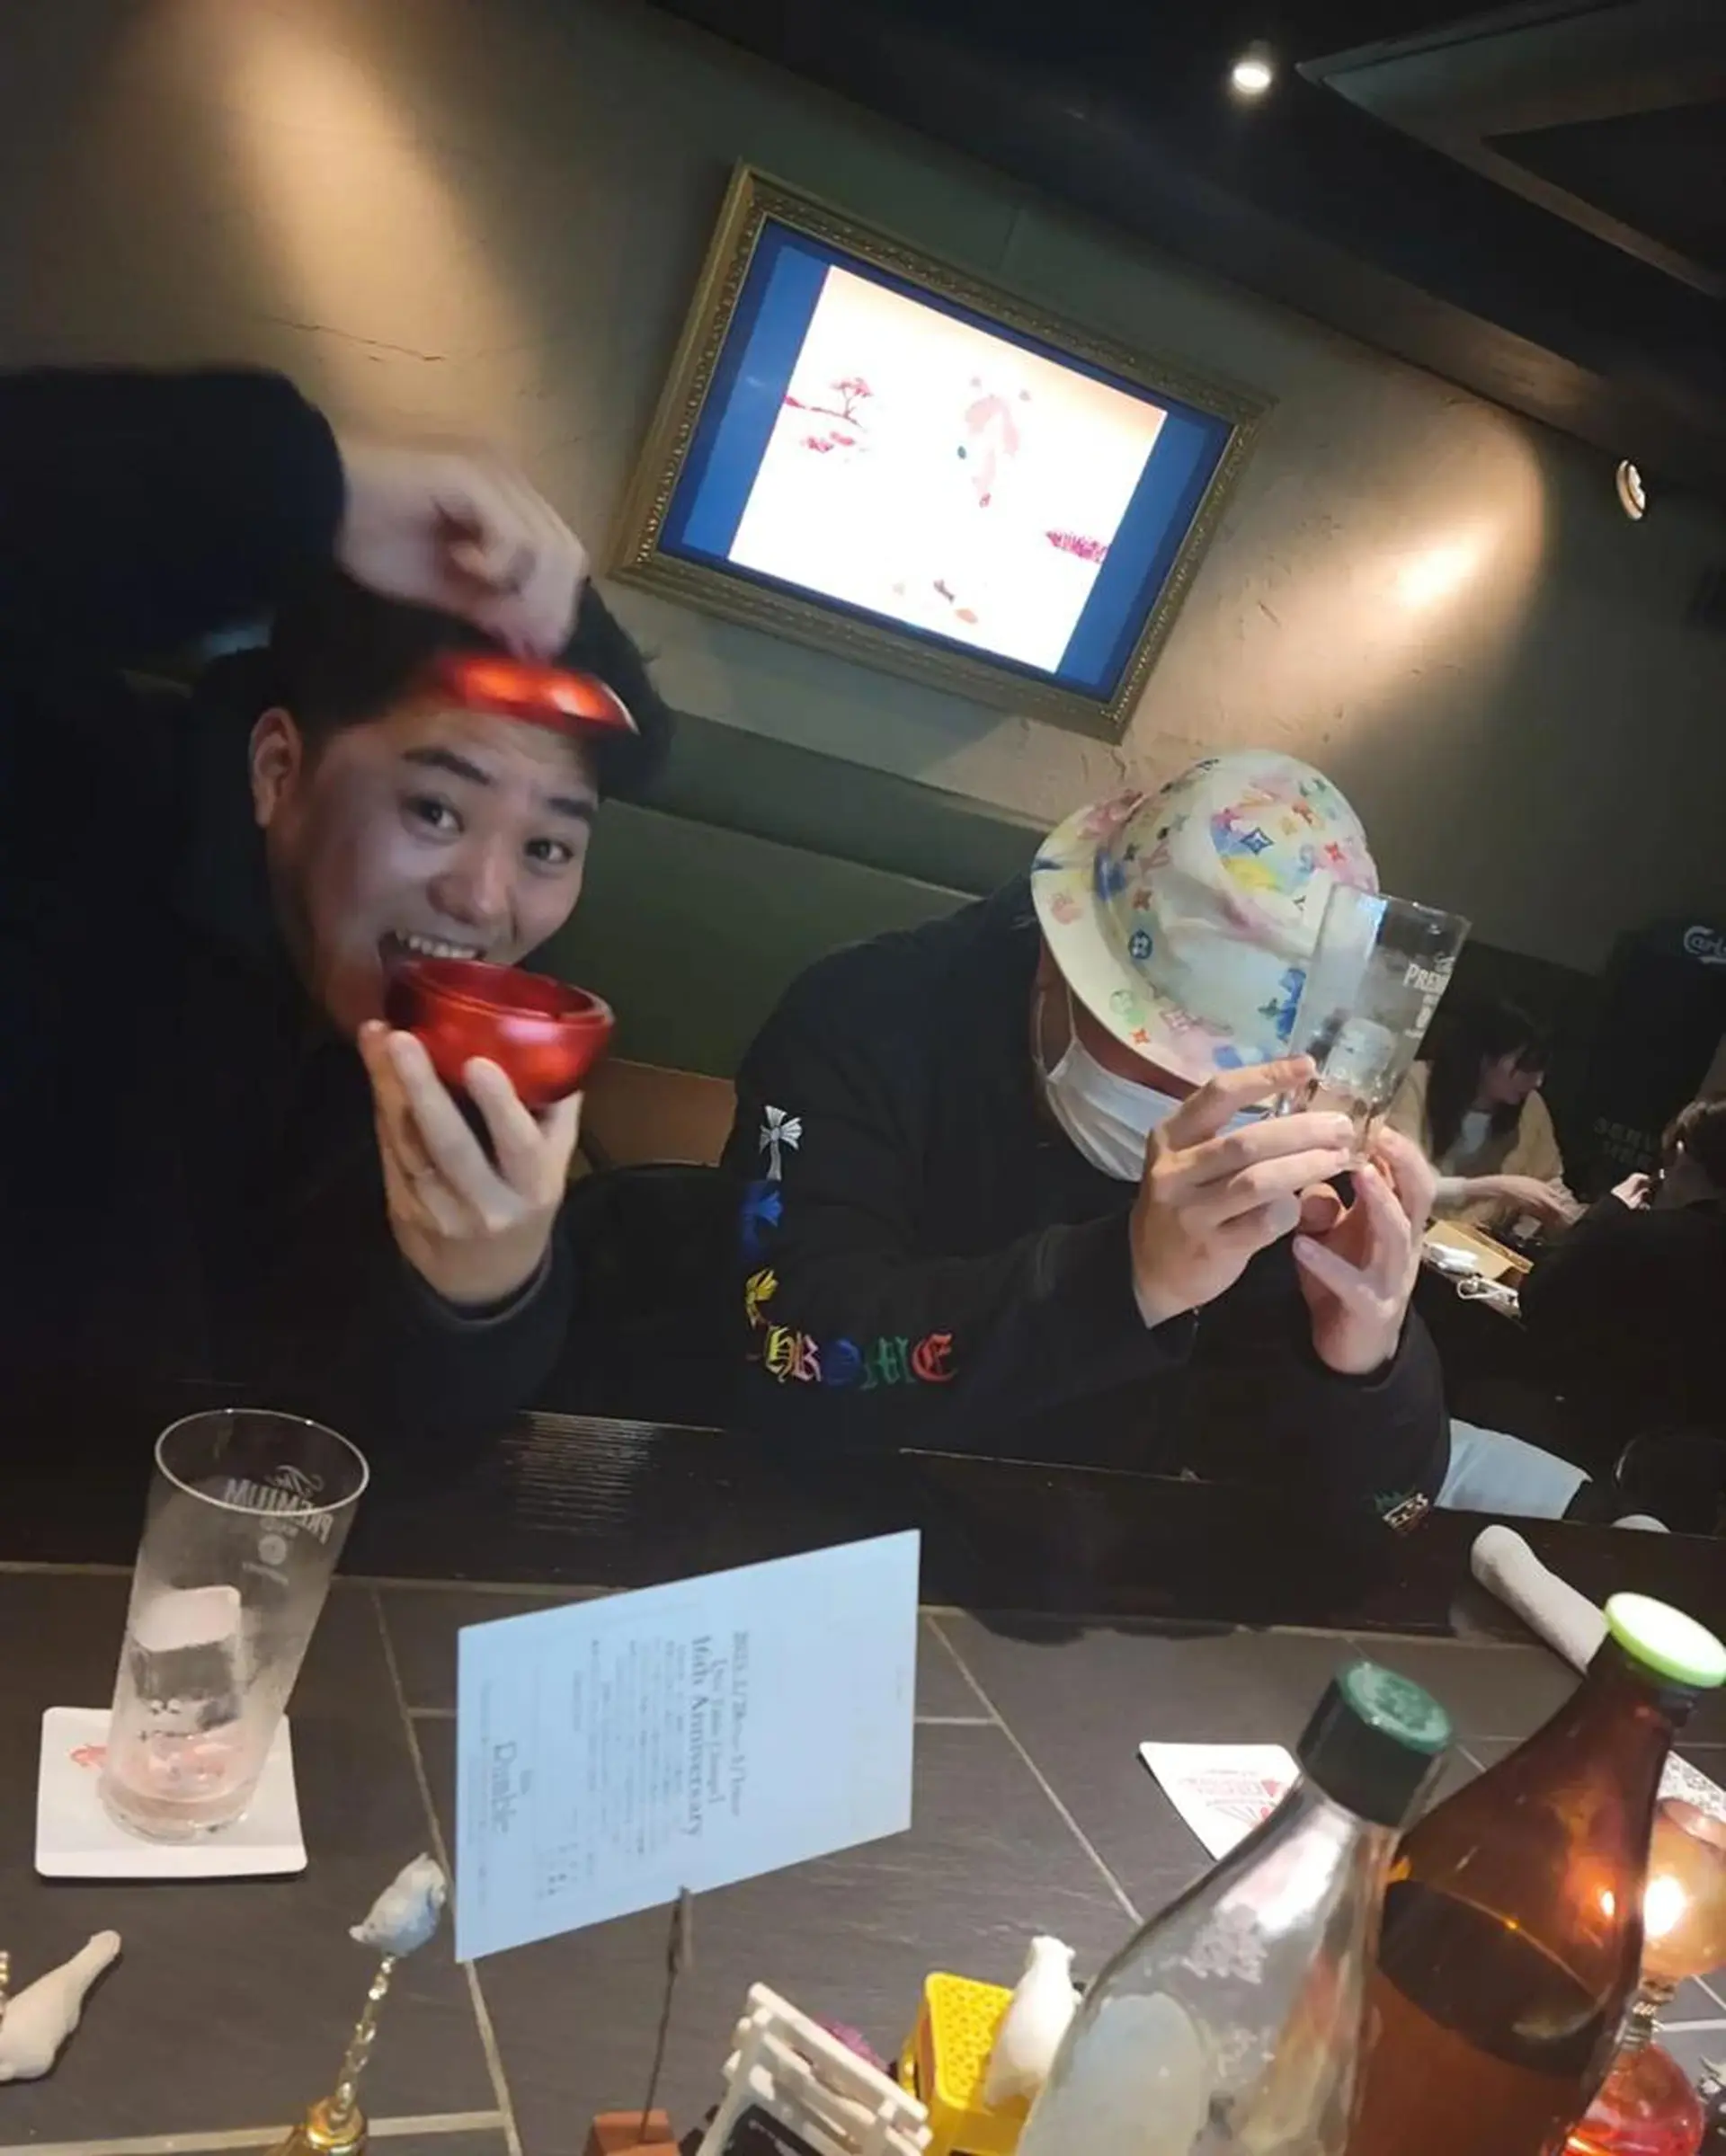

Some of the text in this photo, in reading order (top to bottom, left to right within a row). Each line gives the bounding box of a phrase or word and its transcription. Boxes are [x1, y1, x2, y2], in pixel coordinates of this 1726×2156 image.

[1683, 925, 1726, 957] Carl
[762, 1325, 959, 1391] HROME
[680, 1697, 711, 1838] Anniversary
